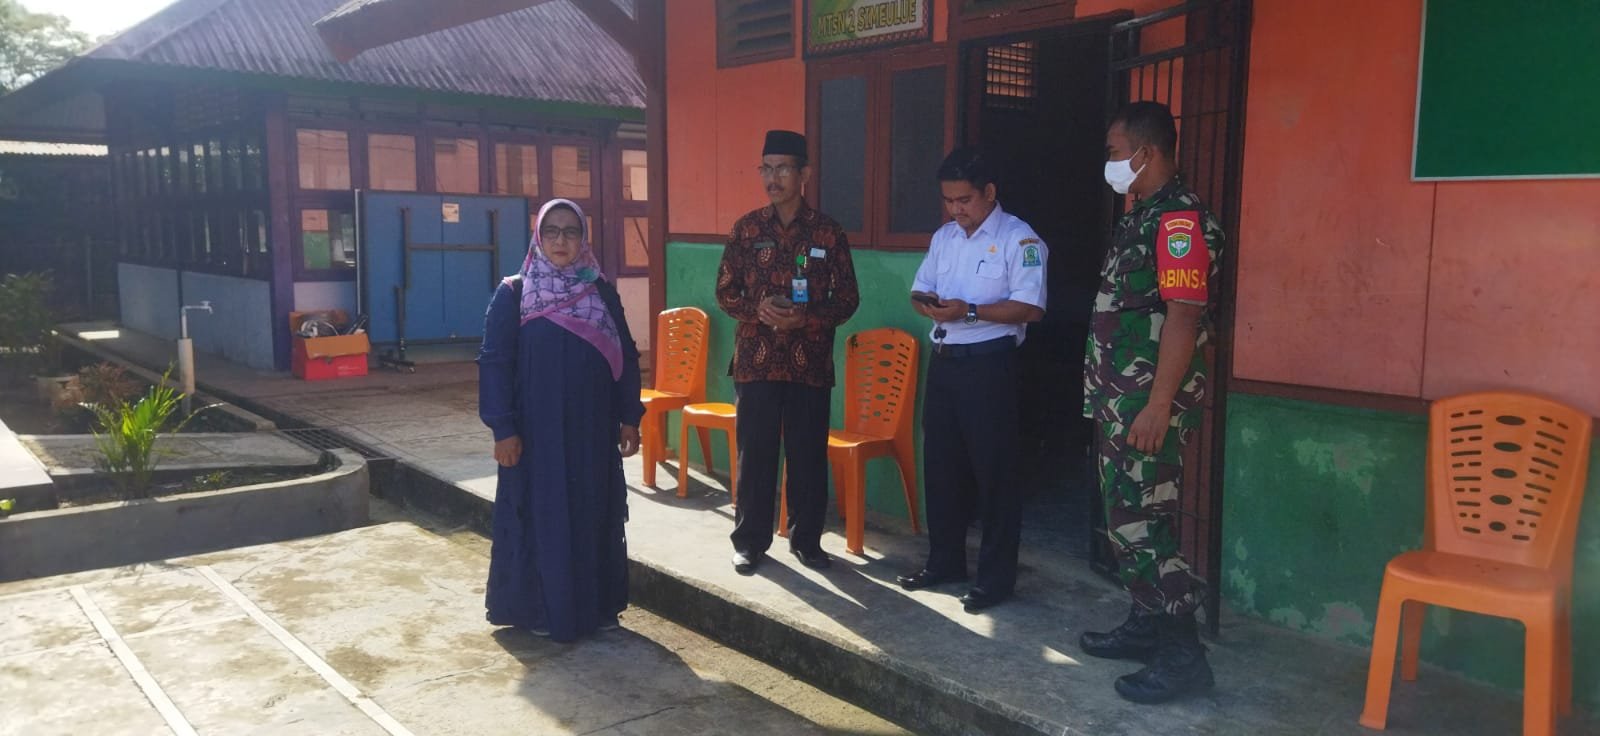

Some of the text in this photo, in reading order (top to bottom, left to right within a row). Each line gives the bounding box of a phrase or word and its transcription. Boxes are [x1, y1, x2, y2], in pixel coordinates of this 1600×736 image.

[847, 8, 856, 33] 2
[857, 1, 916, 31] SIMEULUE
[1159, 268, 1206, 289] ABINSA
